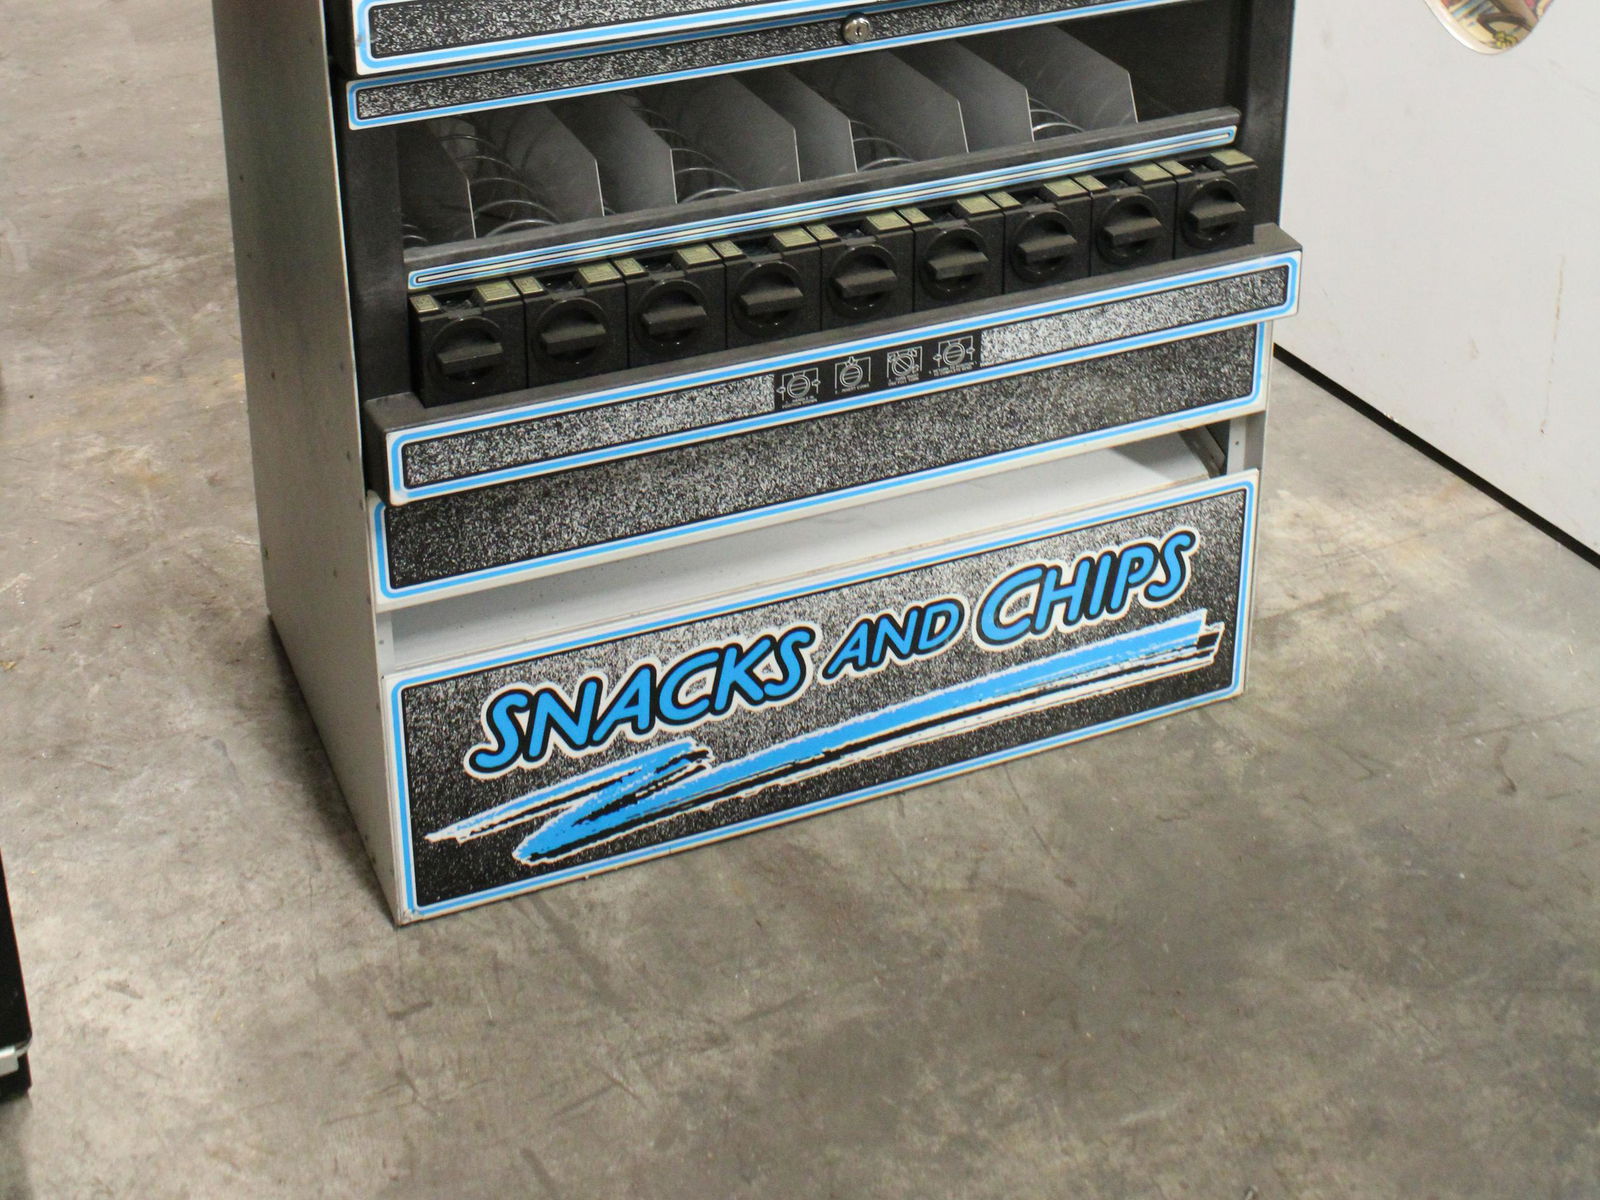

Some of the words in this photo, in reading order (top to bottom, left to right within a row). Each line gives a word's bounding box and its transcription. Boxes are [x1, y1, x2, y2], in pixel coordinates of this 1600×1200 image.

[467, 624, 817, 776] SNACKS
[826, 598, 966, 677] AND
[975, 529, 1199, 647] CHIPS
